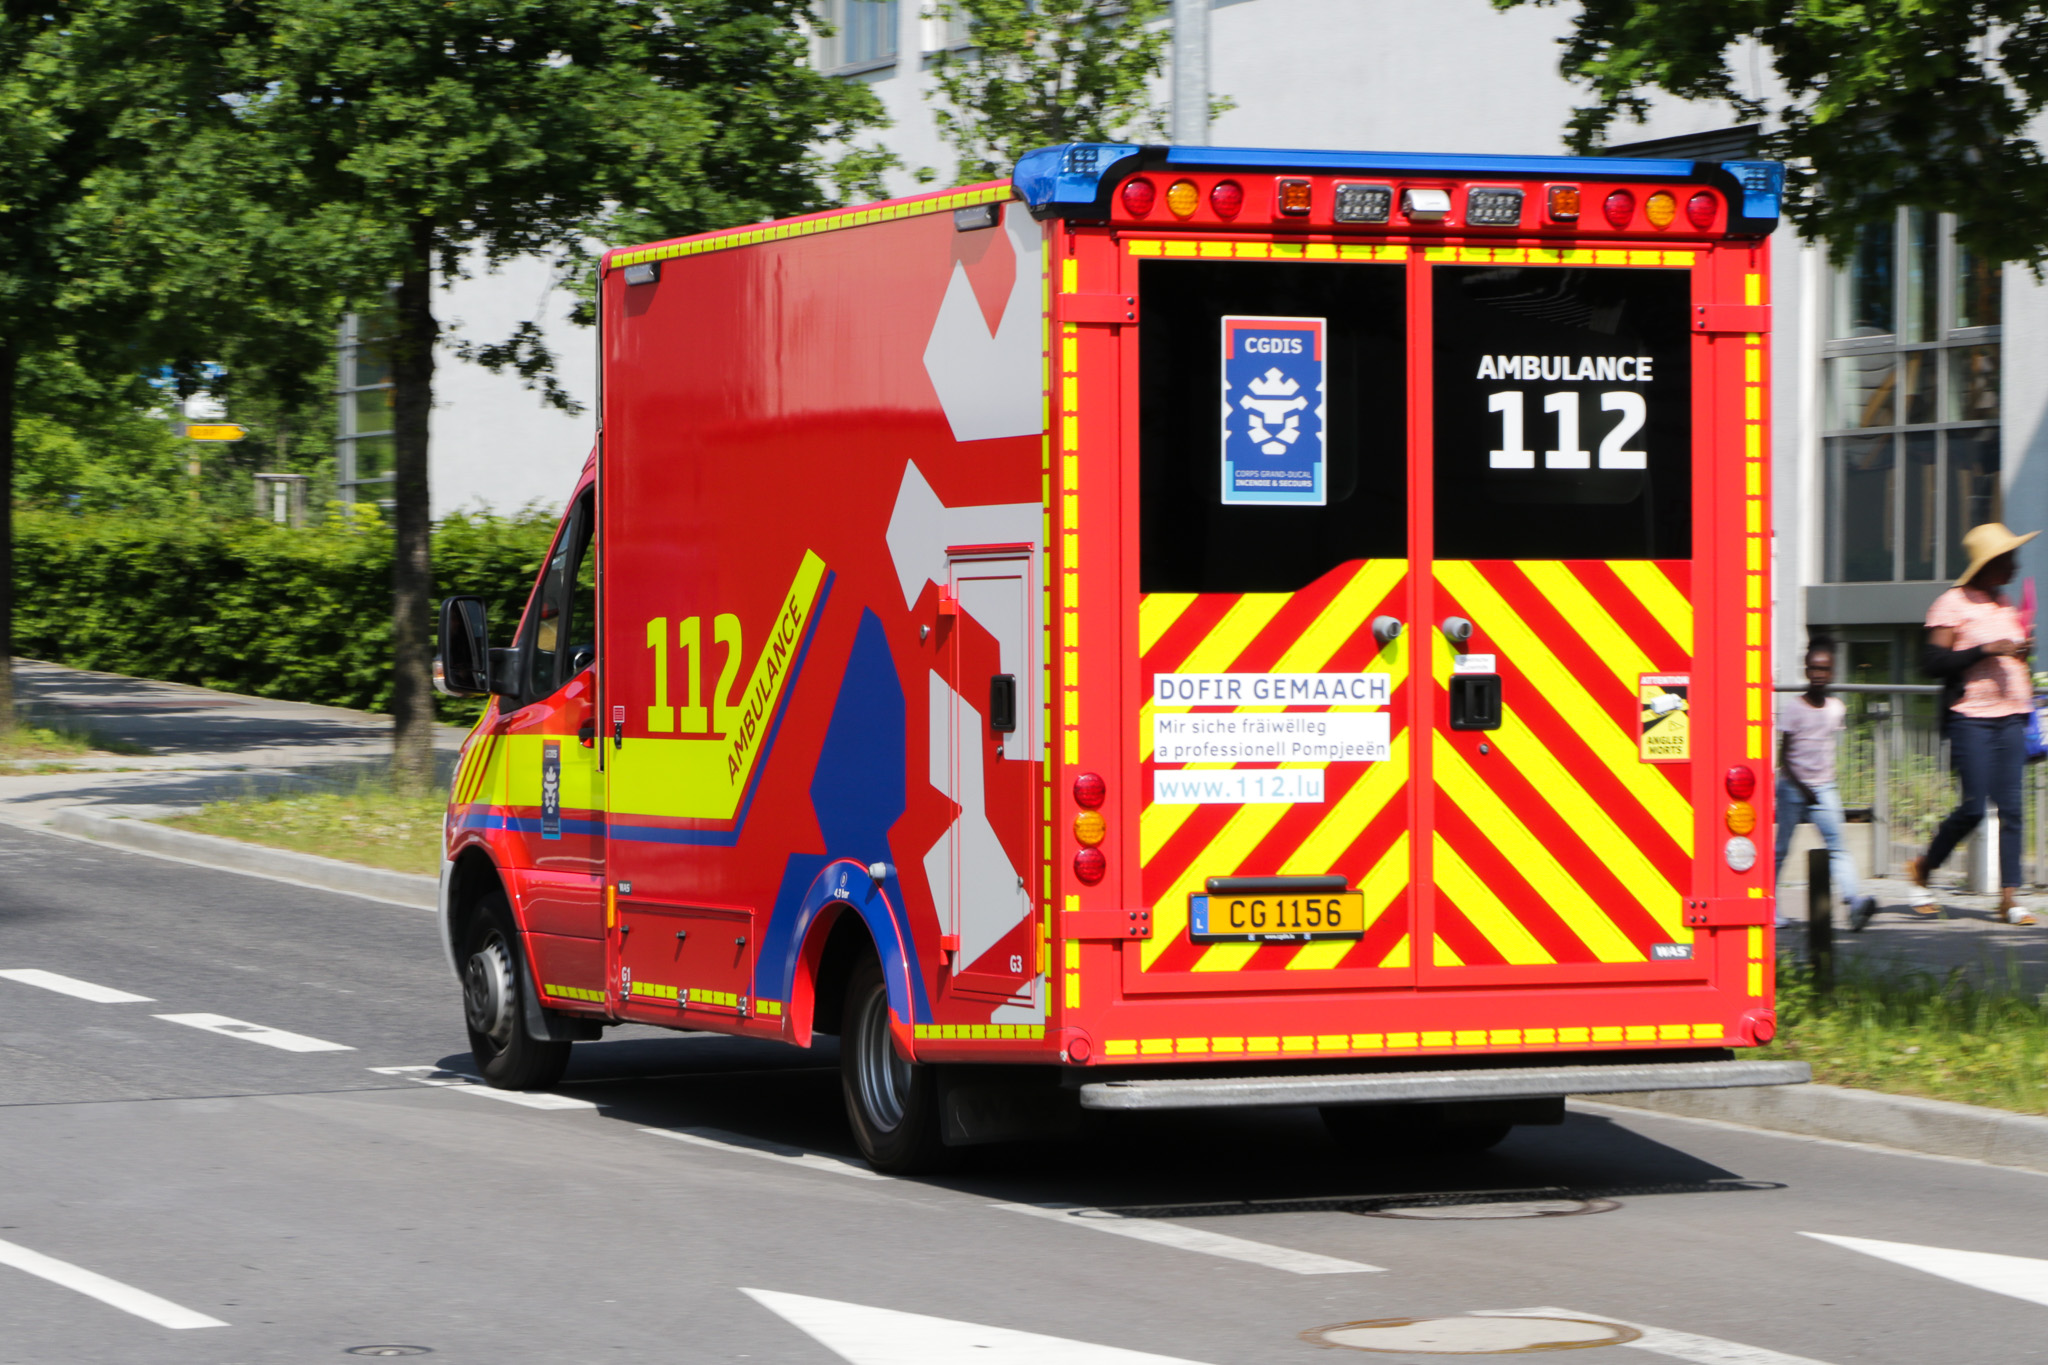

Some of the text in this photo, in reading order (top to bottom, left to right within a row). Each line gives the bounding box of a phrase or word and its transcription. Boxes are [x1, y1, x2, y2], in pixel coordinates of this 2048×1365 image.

[1244, 337, 1303, 354] CGDIS
[1476, 355, 1654, 381] AMBULANCE
[1488, 390, 1648, 469] 112
[1235, 479, 1271, 487] INCENDIE
[1260, 471, 1311, 479] GRAND-DUCAL
[646, 612, 744, 734] 112
[727, 594, 802, 786] AMBULANCE
[1160, 678, 1385, 700] DOFIR GEMAACH
[1159, 717, 1327, 737] Mir siche fräiwëlleg
[1647, 735, 1684, 745] ANGLES
[1159, 740, 1386, 760] a professionell Pompjeeën
[1649, 746, 1682, 754] MORTS
[1159, 774, 1320, 798] www.112.lu
[1196, 917, 1204, 930] L
[1655, 945, 1690, 958] WAS
[1010, 954, 1023, 973] G3
[621, 966, 631, 982] G1
